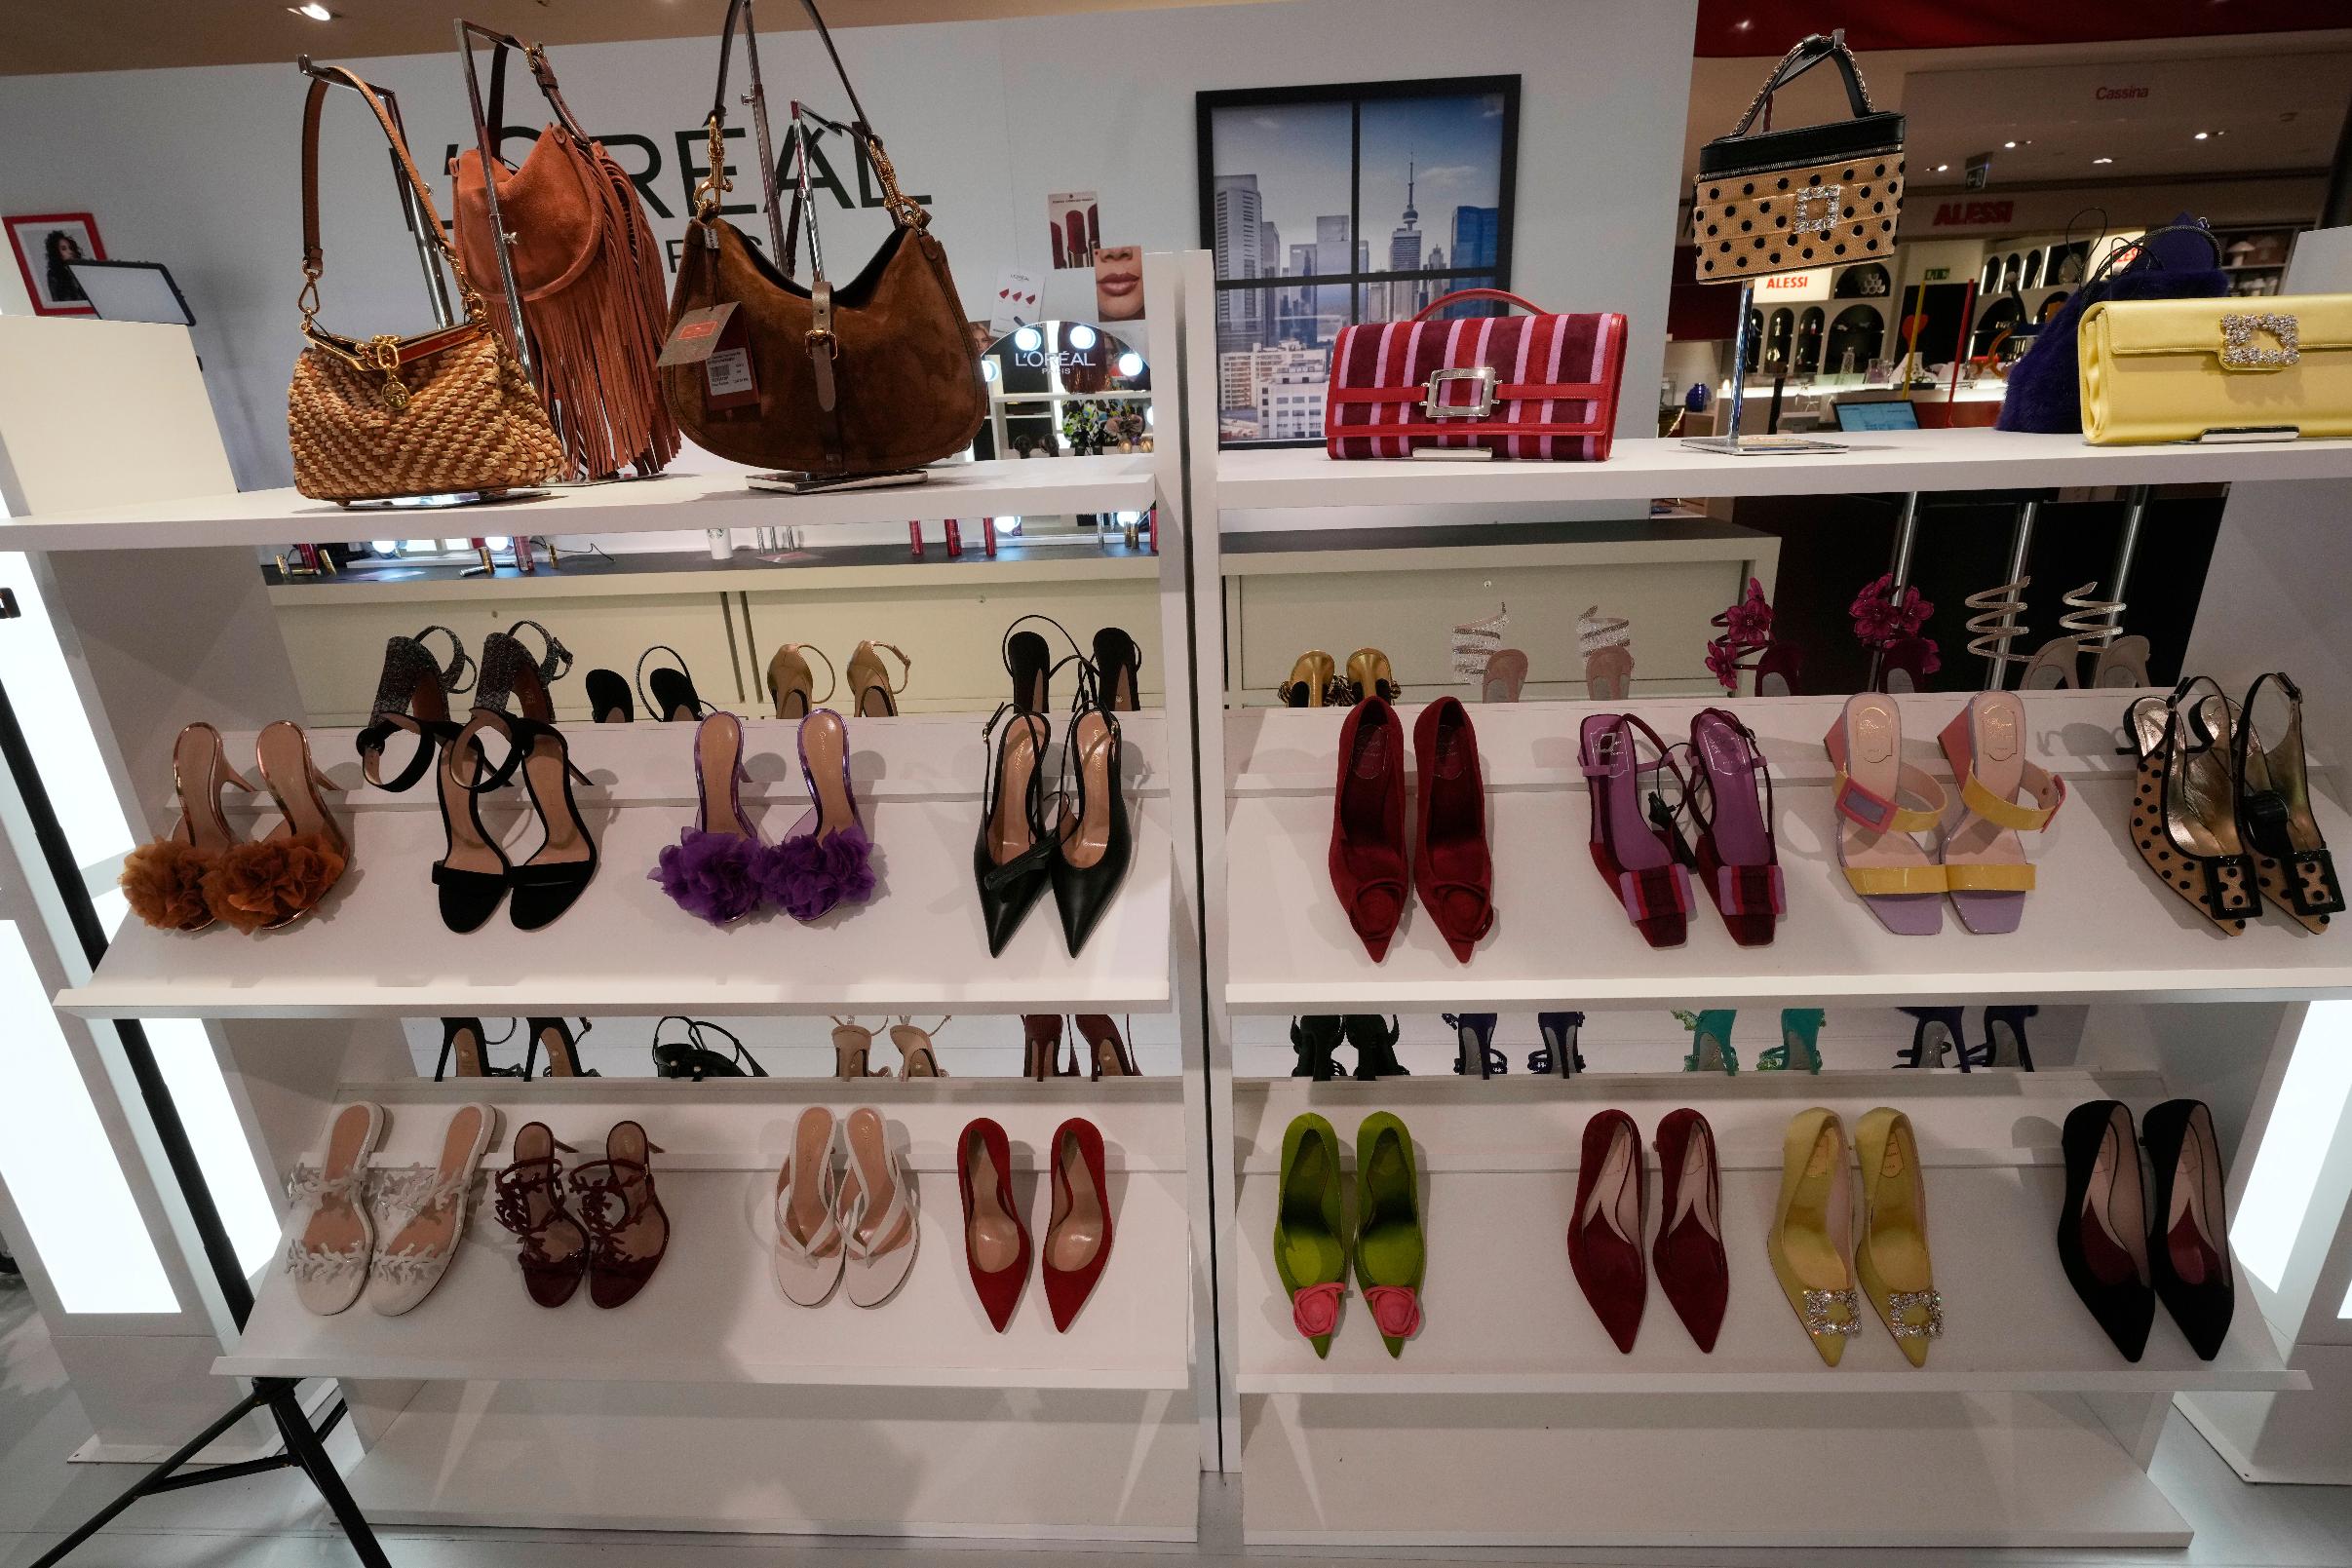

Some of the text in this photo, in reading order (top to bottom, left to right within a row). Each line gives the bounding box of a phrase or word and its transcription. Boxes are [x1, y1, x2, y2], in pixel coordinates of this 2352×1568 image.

[2095, 85, 2149, 100] Cassina
[1932, 200, 2014, 226] ALESSI
[1765, 276, 1809, 289] ALESSI
[1014, 350, 1097, 367] L'ORÉAL
